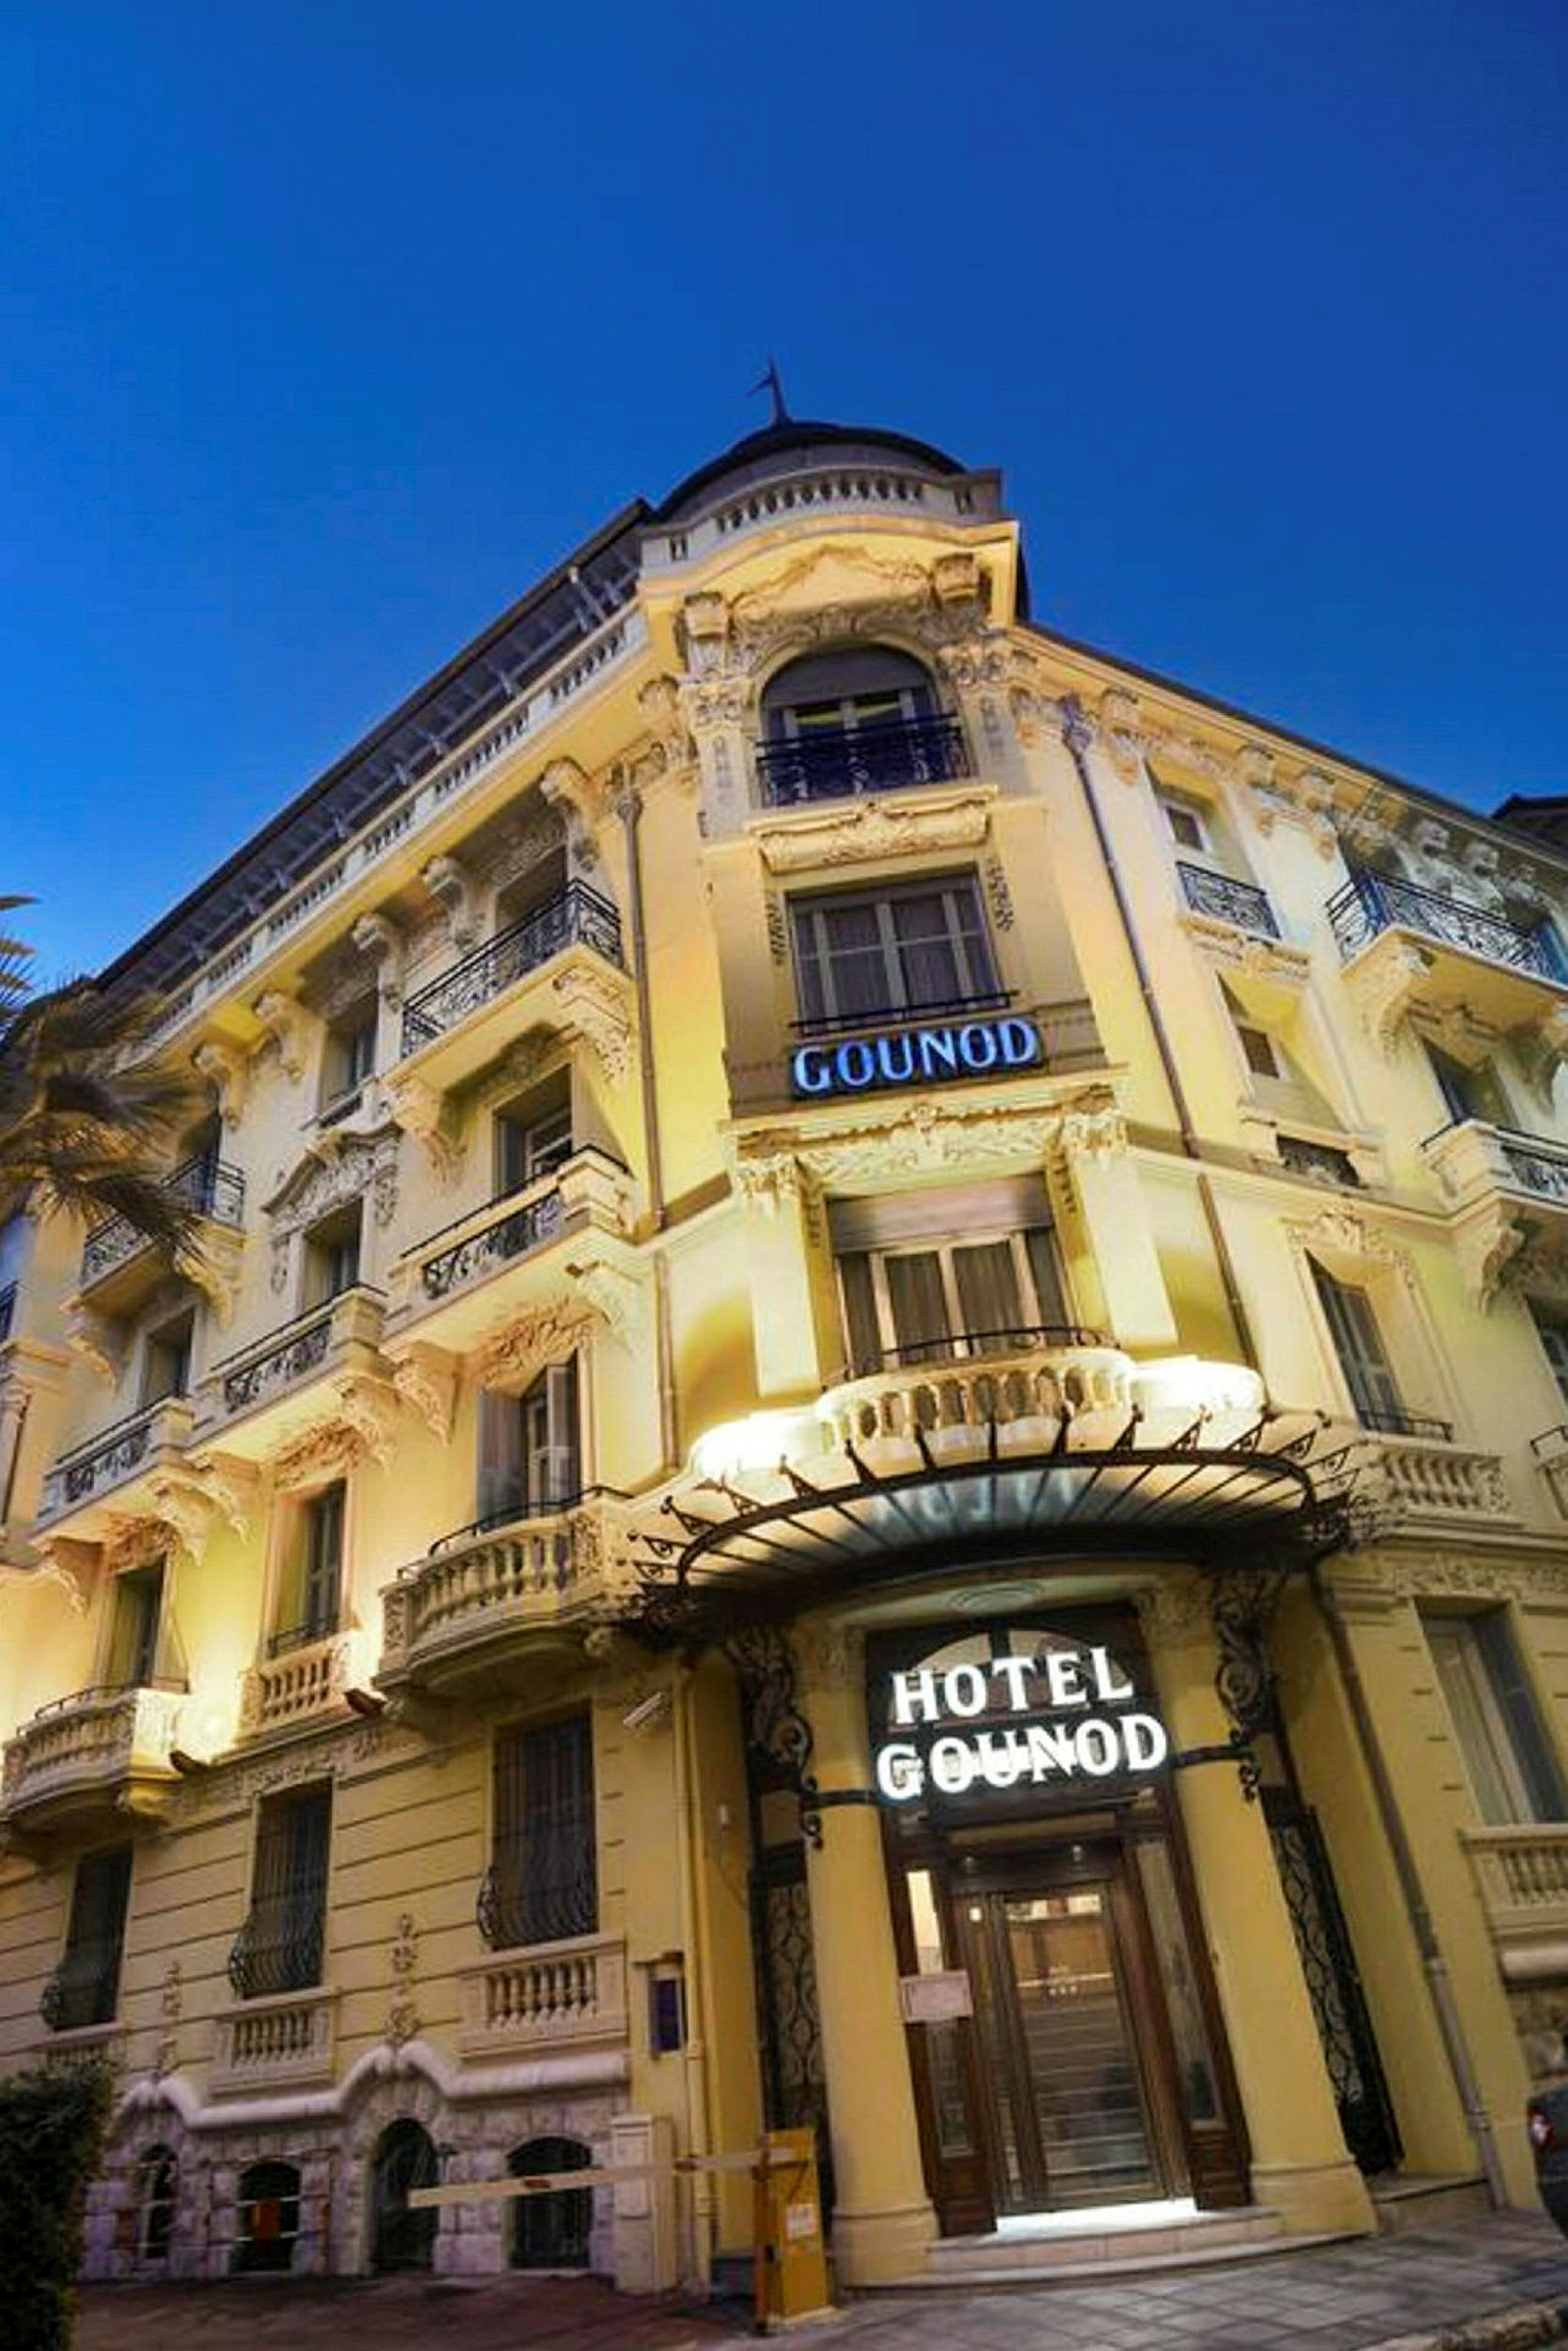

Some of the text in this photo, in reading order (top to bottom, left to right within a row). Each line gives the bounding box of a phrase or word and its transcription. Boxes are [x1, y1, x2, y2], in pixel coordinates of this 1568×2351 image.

[793, 1019, 1038, 1092] GOUNOD
[891, 1646, 1134, 1725] HOTEL
[877, 1713, 1167, 1799] GOUNOD
